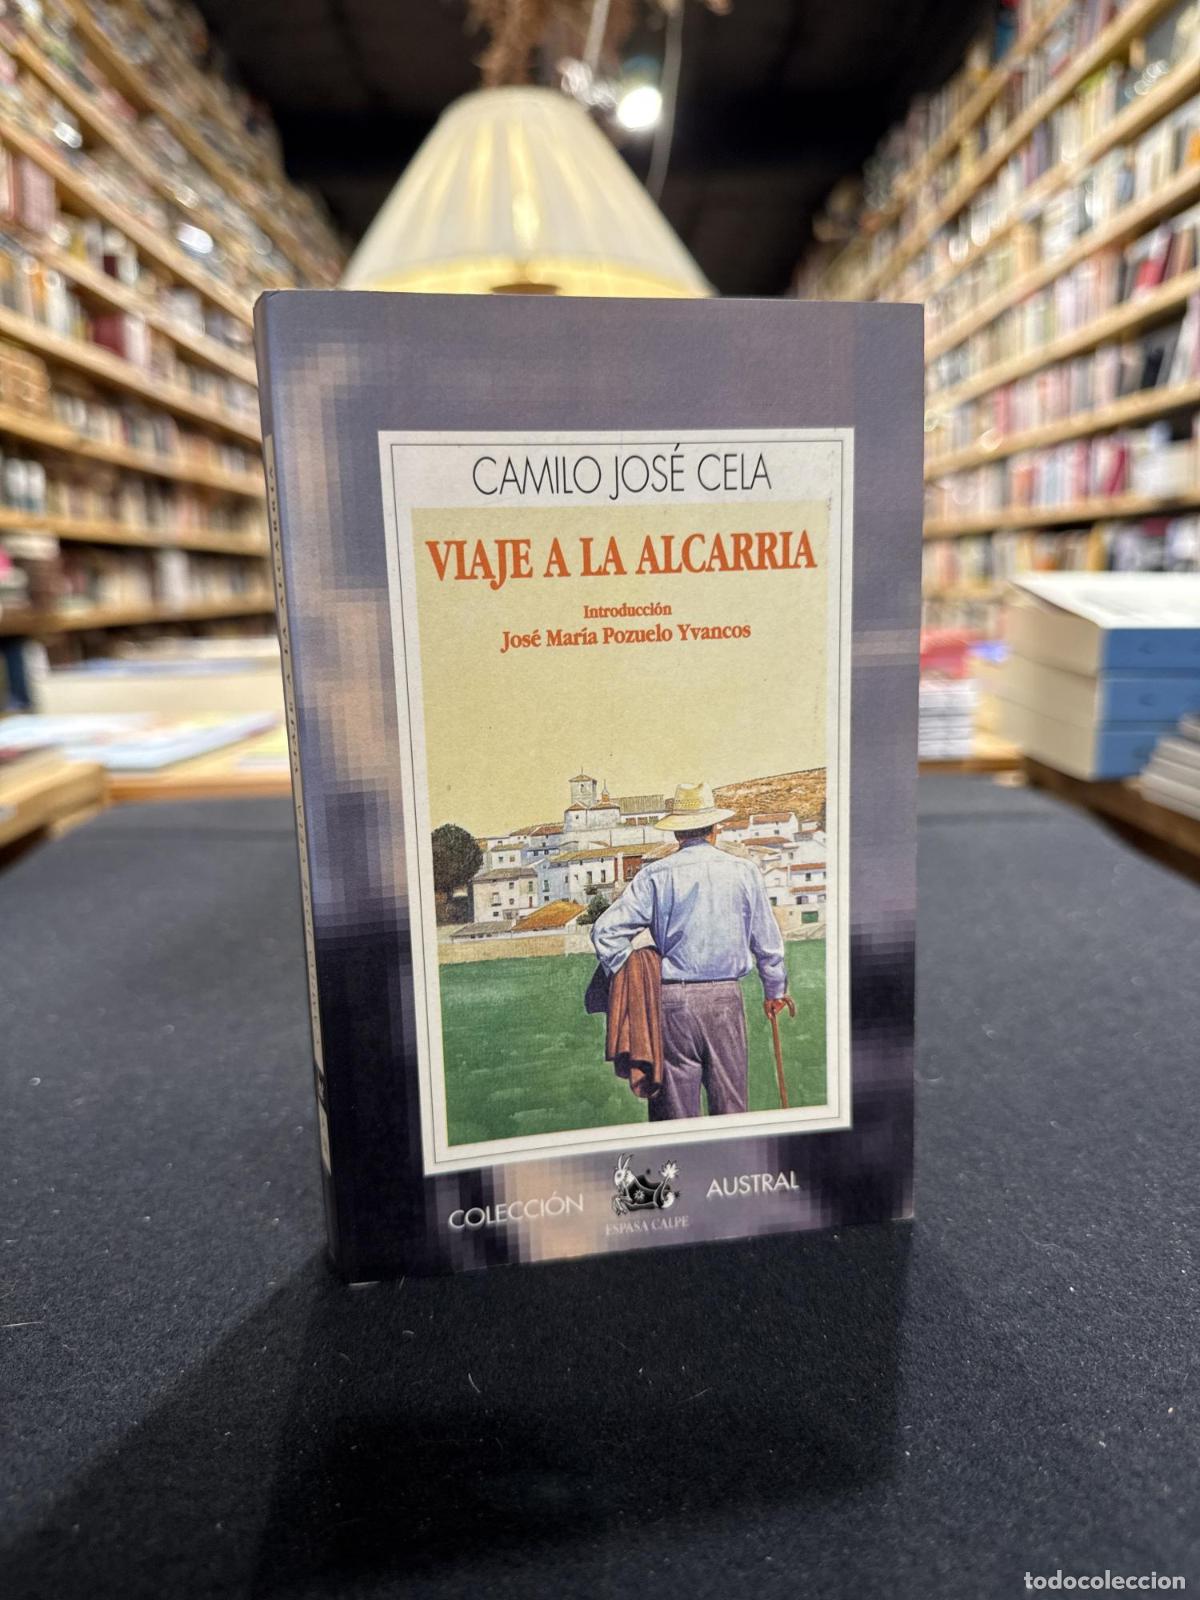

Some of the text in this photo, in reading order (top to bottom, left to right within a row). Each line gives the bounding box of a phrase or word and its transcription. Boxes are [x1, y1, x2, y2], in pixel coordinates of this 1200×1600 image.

[473, 443, 772, 500] CAMILO JOSÉ CELA
[425, 529, 818, 590] VIAJE A LA ALCARRIA
[583, 602, 672, 619] Introducción
[500, 622, 752, 654] José María Pozuelo Yvancos
[448, 1170, 800, 1230] COLECCIÓN AUSTRAL
[605, 1215, 690, 1236] ESPASA CALPE
